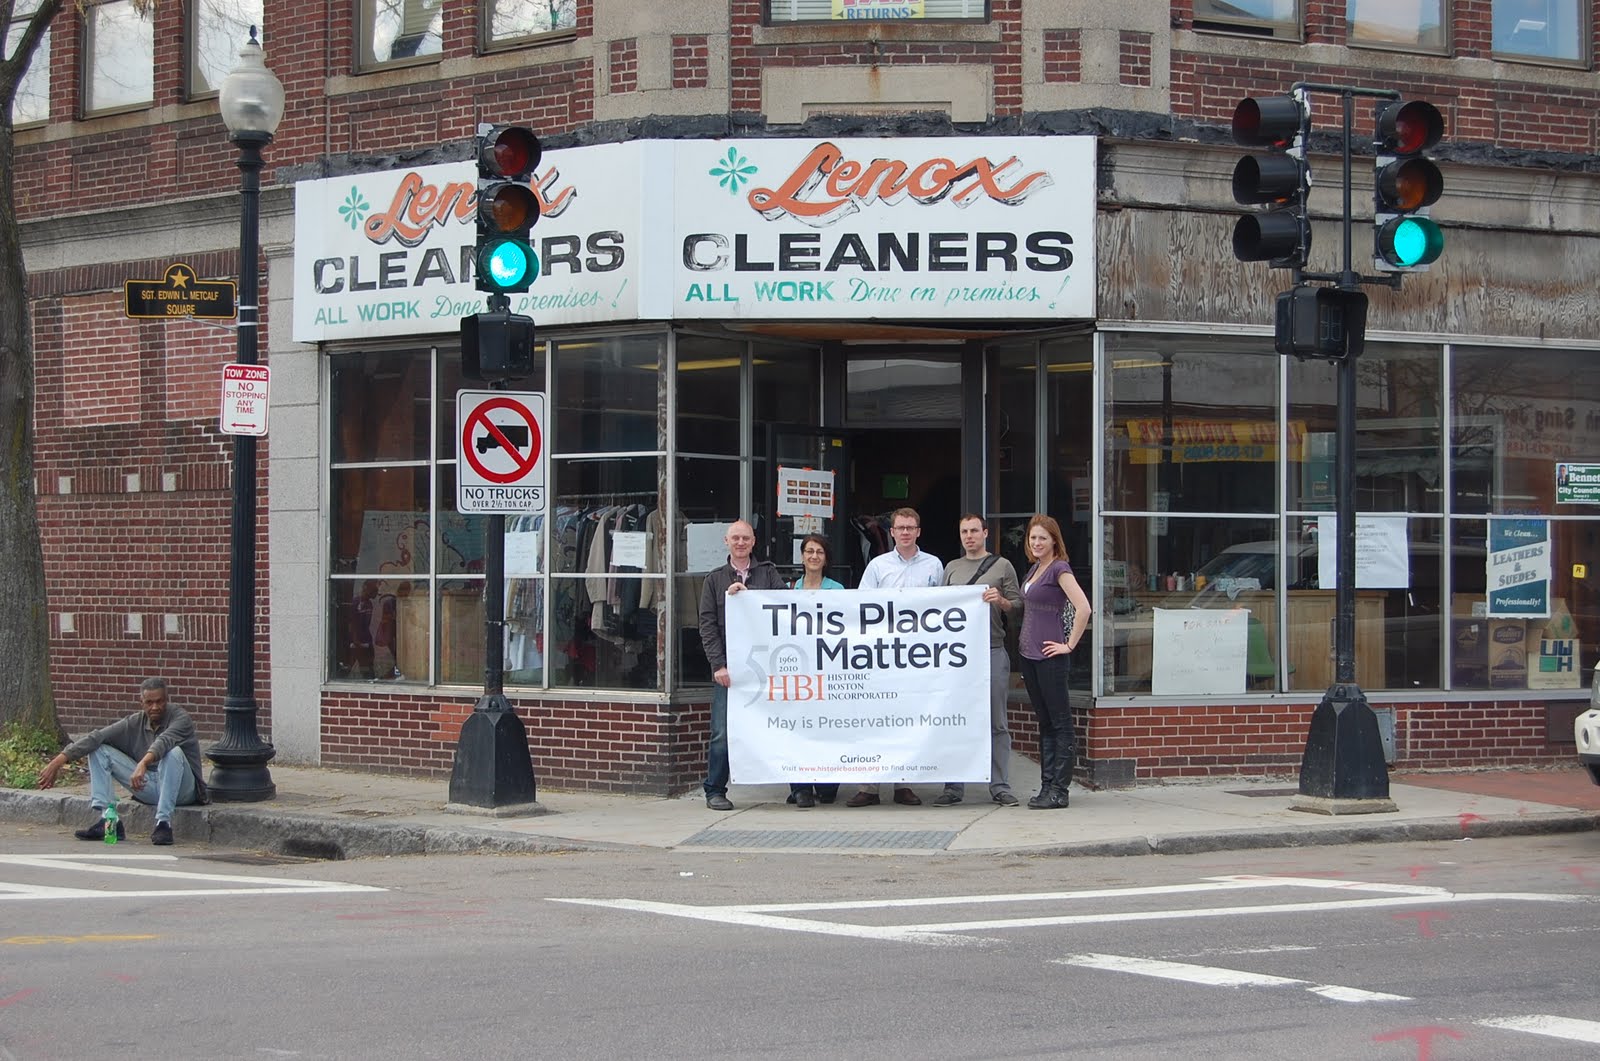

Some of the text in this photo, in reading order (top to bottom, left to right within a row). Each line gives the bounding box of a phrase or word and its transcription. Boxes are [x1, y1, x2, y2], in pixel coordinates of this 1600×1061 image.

[847, 7, 910, 20] RETURNS
[746, 141, 1055, 228] Lenox
[364, 166, 578, 248] Lenx
[682, 231, 1074, 272] CLEANERS
[313, 230, 625, 294] CLEANRS
[141, 290, 156, 300] SGT.
[158, 291, 180, 300] EDWIN
[190, 291, 220, 301] METCALF
[685, 283, 739, 302] ALL
[754, 279, 837, 302] WORK
[846, 277, 898, 302] Done
[910, 287, 937, 302] on
[166, 304, 196, 315] SQUARE
[314, 307, 348, 326] ALL
[357, 299, 420, 322] WORK
[430, 295, 483, 319] Done
[225, 368, 268, 380] TOW ZONE
[238, 382, 254, 392] NO
[226, 391, 266, 400] STOPPING
[1569, 465, 1586, 473] Doug
[465, 488, 540, 500] NO TRUCKS
[1504, 529, 1513, 537] We
[1493, 545, 1544, 566] LEATHERS
[1514, 561, 1522, 573] &
[1498, 569, 1537, 587] SUEDES
[1495, 597, 1541, 608] Professionally!
[762, 601, 967, 637] This Place
[778, 656, 798, 664] 1960
[816, 637, 968, 671] Matters
[778, 665, 799, 673] 2010
[743, 643, 809, 708] 50
[827, 673, 870, 681] HISTORIC
[766, 673, 826, 701] HBI
[827, 682, 864, 691] BOSTON
[827, 691, 898, 701] INCORPORATED
[767, 713, 967, 731] May is Preservation Month
[839, 754, 882, 763] Curious?
[798, 765, 880, 773] www.historicboston.org
